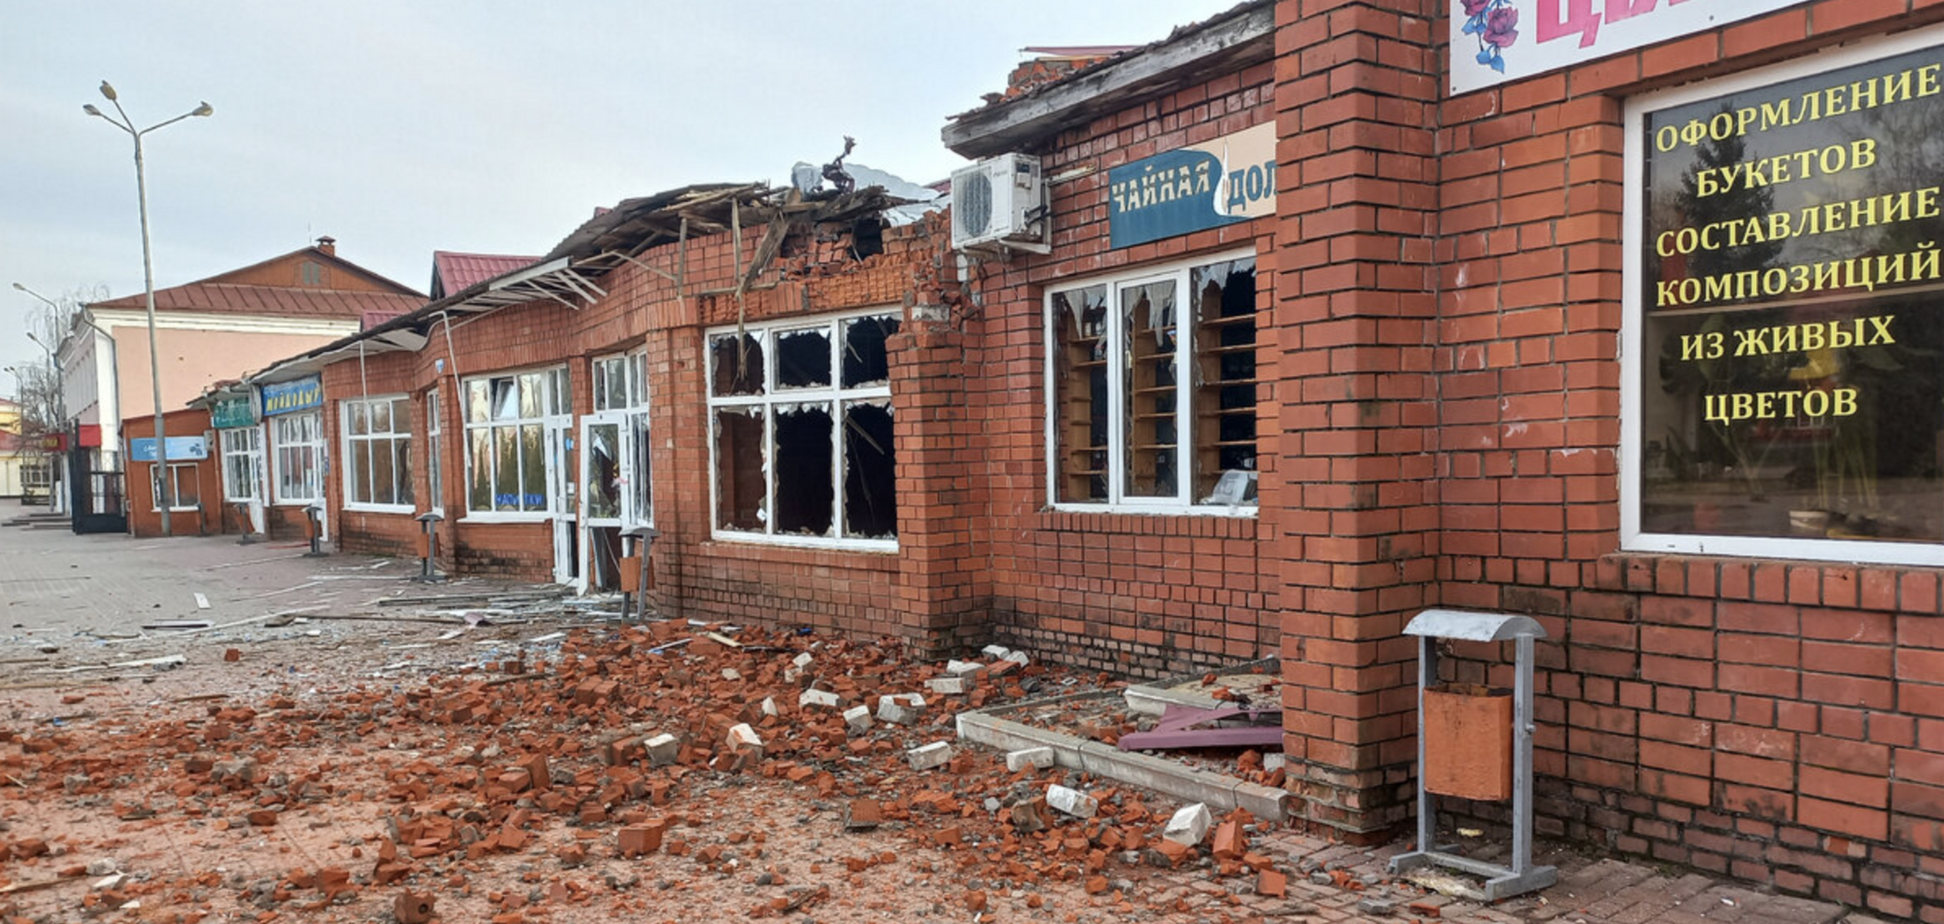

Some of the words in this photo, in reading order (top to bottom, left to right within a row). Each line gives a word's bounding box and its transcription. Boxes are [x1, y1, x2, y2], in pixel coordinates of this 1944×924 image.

[1656, 63, 1941, 153] ОФОРМЛЕНИЕ
[1112, 159, 1210, 213] ЧАЙНАЯ
[1696, 138, 1877, 198] БУКЕТОВ
[1656, 186, 1940, 258] СОСТАВЛЕНИЕ
[1656, 241, 1942, 307] КОМПОЗИЦИЙ
[1680, 332, 1725, 361] ИЗ
[1733, 315, 1896, 358] ЖИВЫХ
[1704, 388, 1859, 426] ЦВЕТОВ
